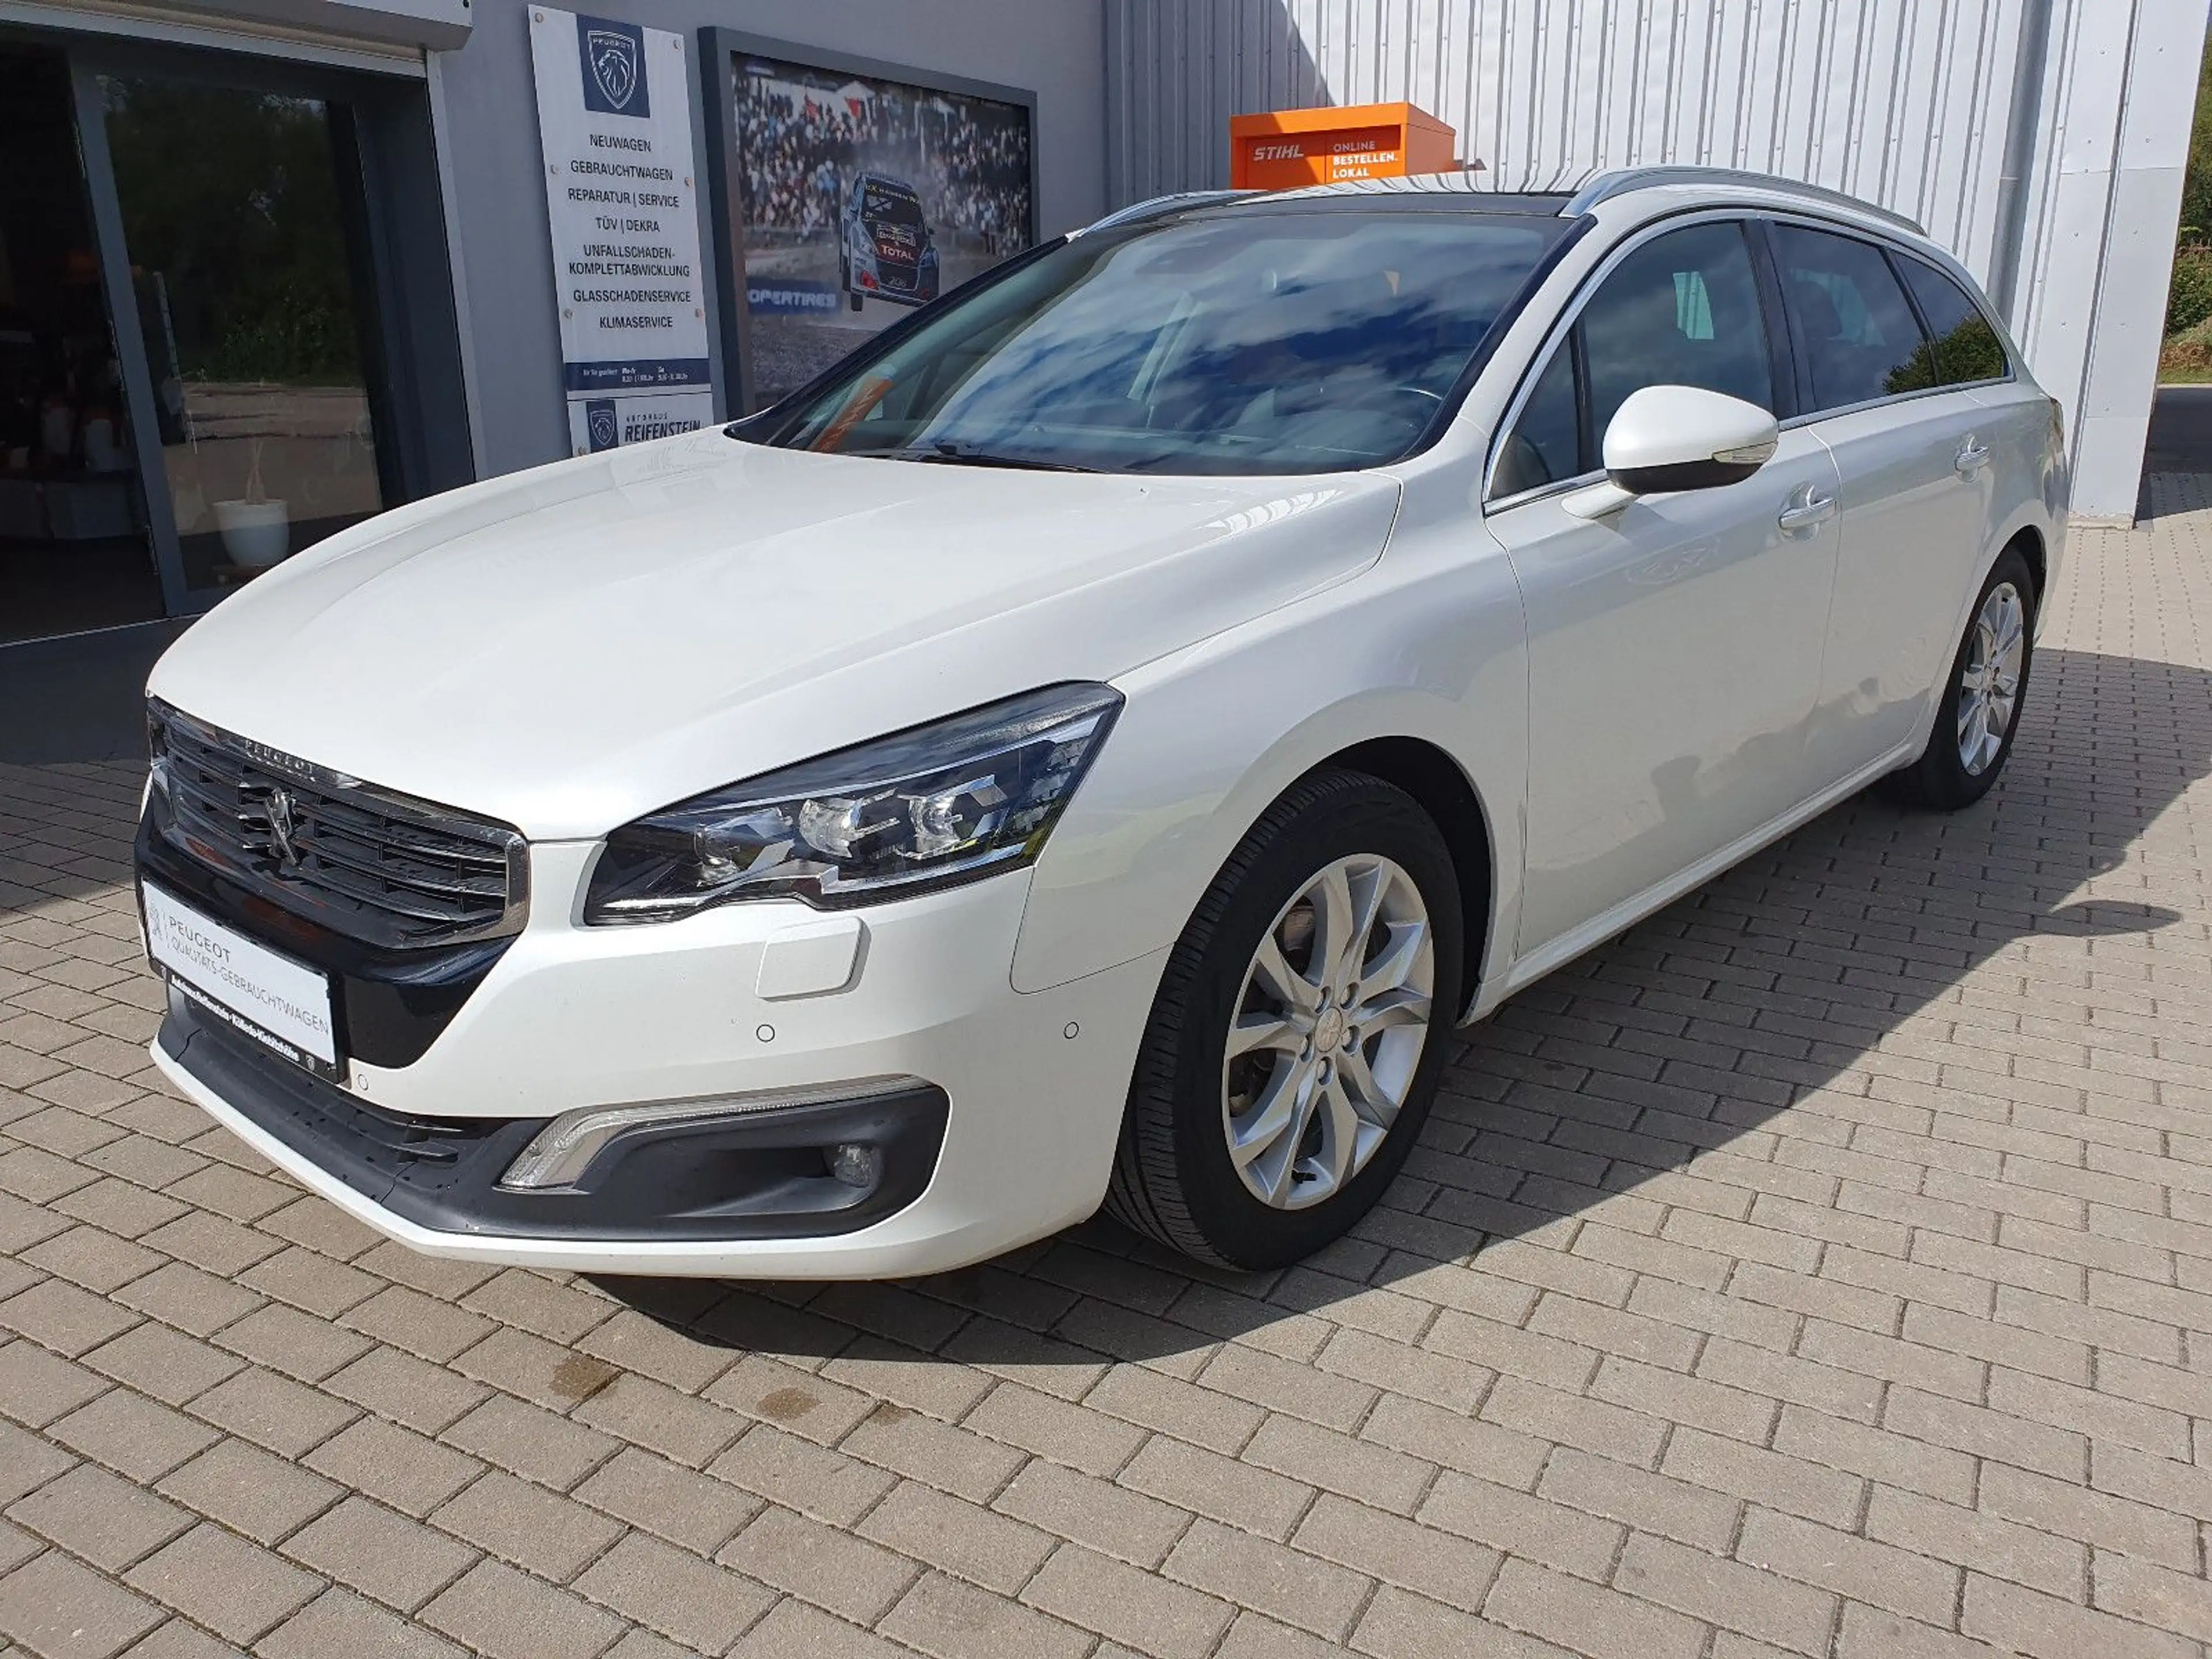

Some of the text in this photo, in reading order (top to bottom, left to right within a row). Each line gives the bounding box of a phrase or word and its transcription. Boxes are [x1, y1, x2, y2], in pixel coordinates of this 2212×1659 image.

[590, 134, 652, 152] NEUWAGEN
[1334, 141, 1376, 153] ONLINE
[1253, 143, 1304, 161] STIHL
[1333, 153, 1398, 166] BESTELLEN.
[570, 160, 673, 181] GEBRAUCHTWAGEN
[1333, 169, 1370, 179] LOKAL
[568, 188, 630, 203] REPARATUR
[638, 193, 680, 207] SERVICE
[596, 215, 618, 230] TÜV
[626, 219, 661, 232] DEKRA
[584, 245, 676, 259] UNFALLSCHADEN-
[881, 244, 915, 261] TOTAL
[569, 262, 690, 277] KOMPLETTABWICKLUNG
[573, 290, 691, 303] GLASSCHADENSERVICE
[600, 316, 673, 329] KLIMASERVICE
[625, 420, 701, 442] REIFENSTEIN
[245, 740, 315, 774] PEUGEOT
[169, 915, 230, 963] PEUGEOT
